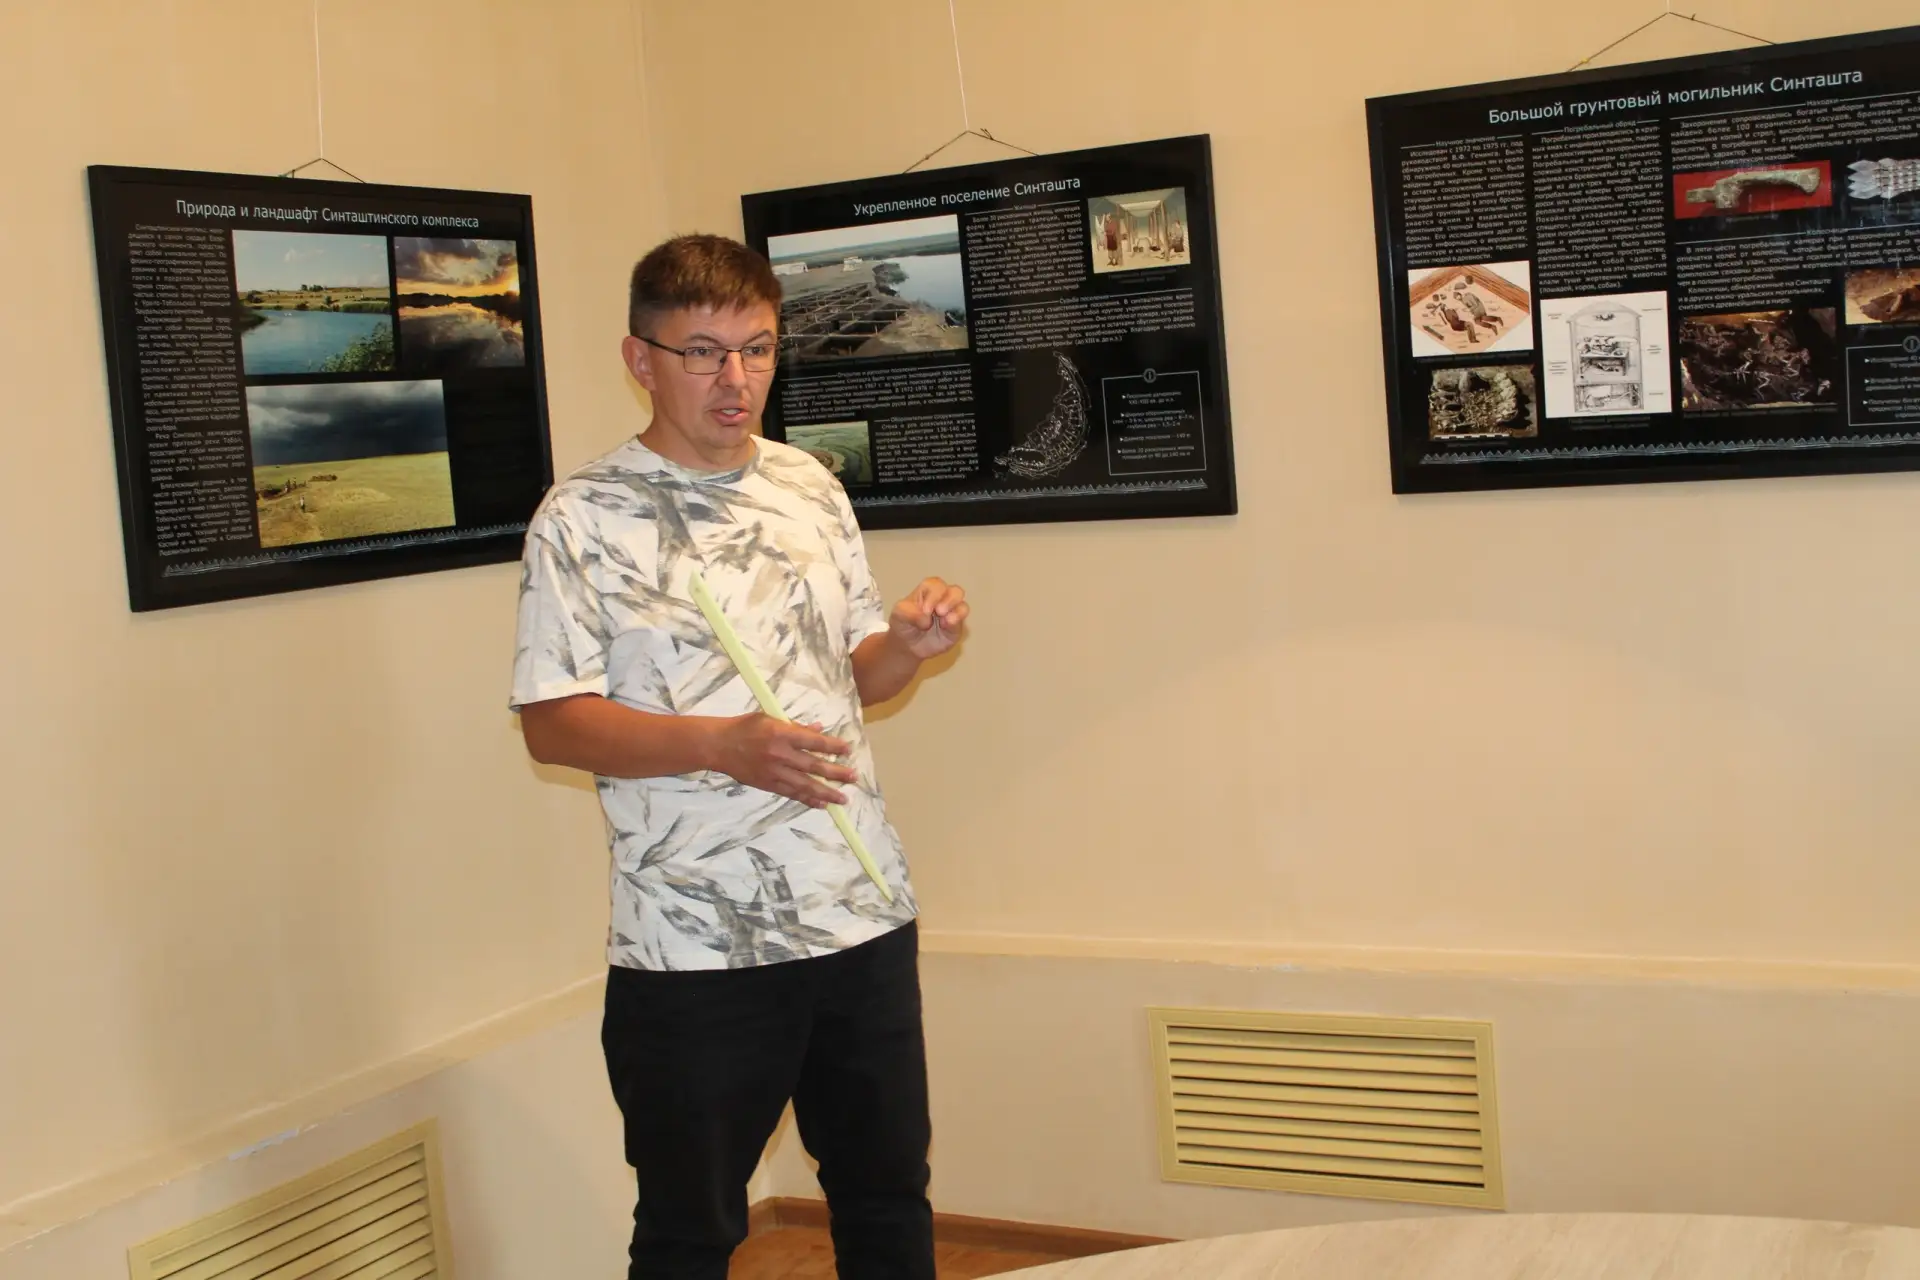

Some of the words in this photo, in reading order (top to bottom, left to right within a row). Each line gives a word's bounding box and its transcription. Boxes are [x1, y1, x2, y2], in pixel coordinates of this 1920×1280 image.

[1488, 102, 1564, 124] Большой
[1569, 91, 1662, 116] грунтовый
[1668, 81, 1764, 103] могильник
[1770, 71, 1863, 92] Синташта
[176, 200, 236, 218] Природа
[241, 206, 249, 217] и
[253, 206, 318, 224] ландшафт
[322, 208, 419, 226] Синташтинского
[422, 214, 479, 228] комплекса
[853, 196, 937, 216] Укрепленное
[941, 185, 1010, 205] поселение
[1014, 177, 1081, 196] Синташта
